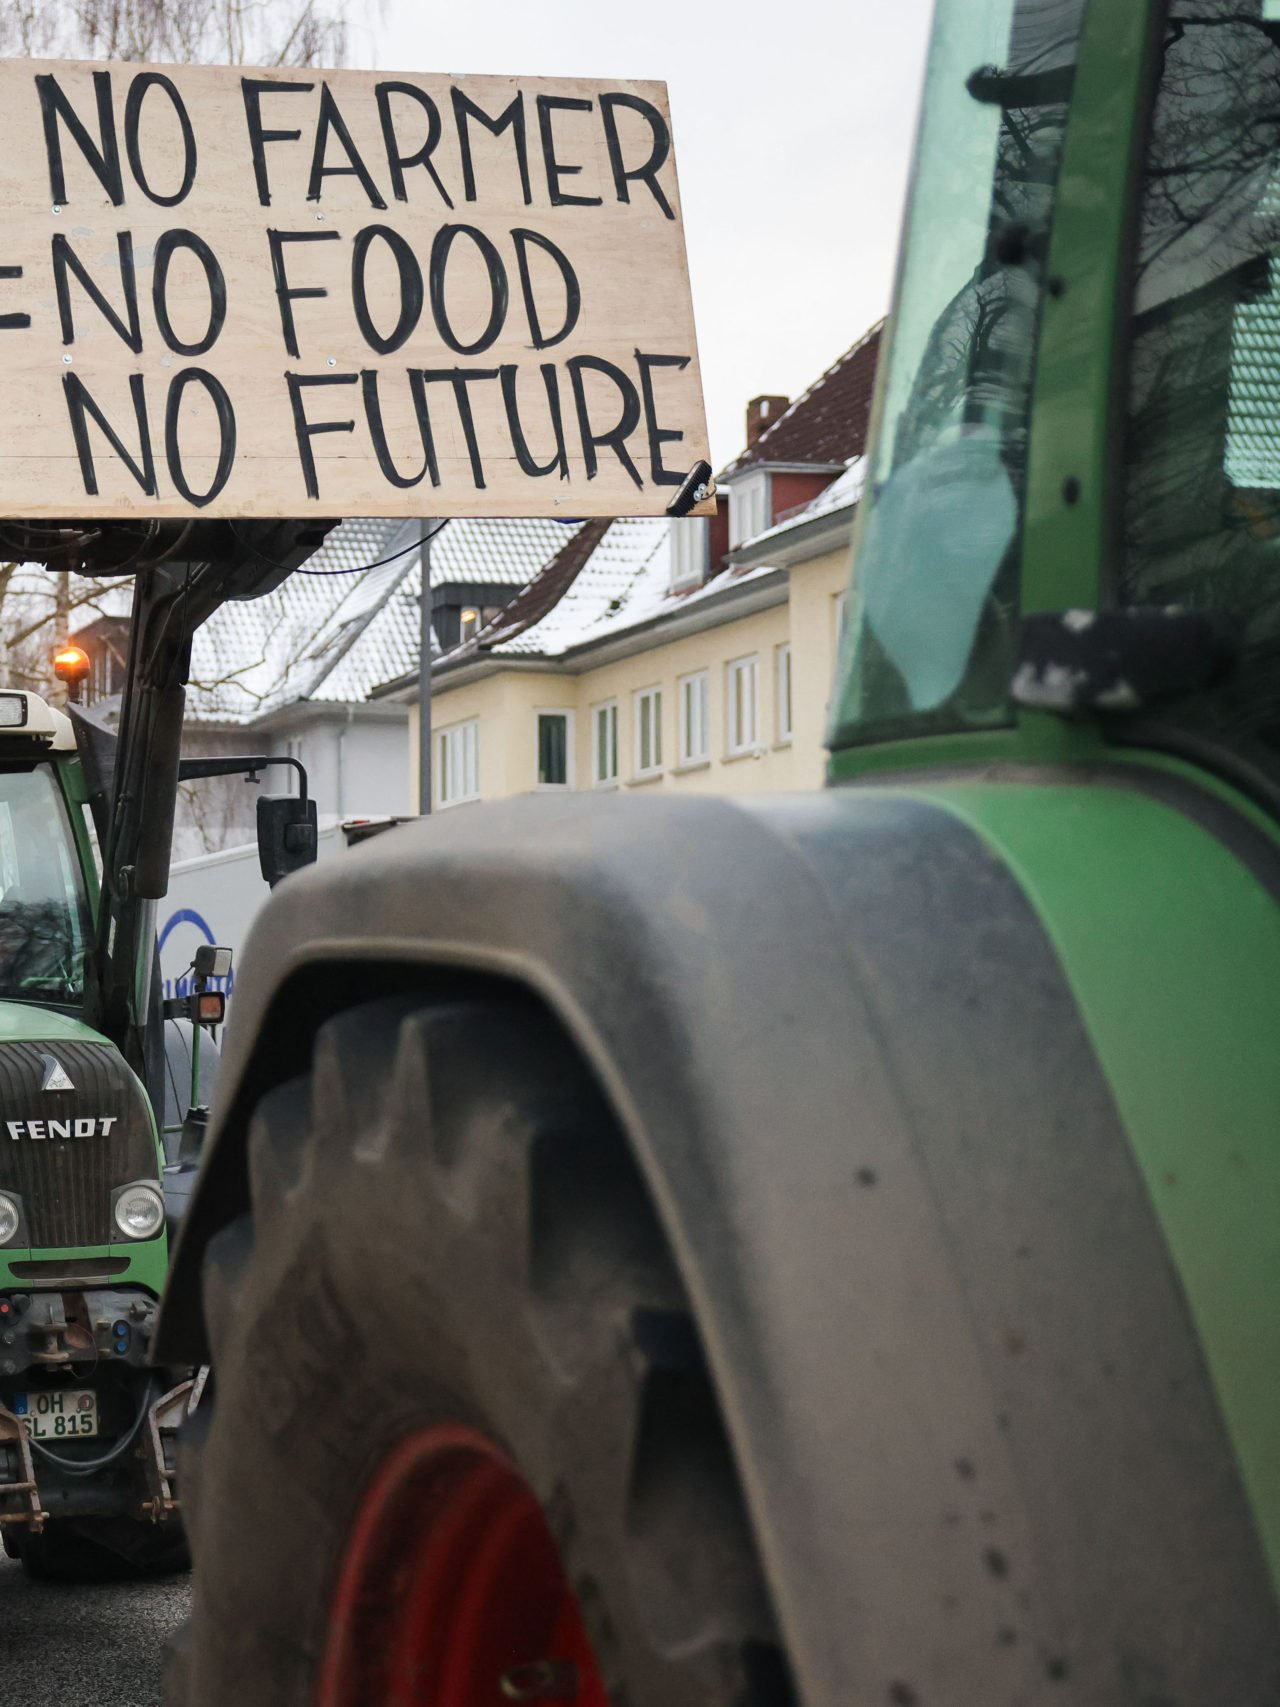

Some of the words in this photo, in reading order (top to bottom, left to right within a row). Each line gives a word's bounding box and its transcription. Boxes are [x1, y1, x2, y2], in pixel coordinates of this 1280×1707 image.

[35, 71, 198, 208] NO
[241, 77, 676, 221] FARMER
[52, 229, 227, 357] NO
[267, 224, 581, 356] FOOD
[62, 367, 237, 509] NO
[284, 348, 692, 500] FUTURE
[6, 1117, 118, 1141] FENDT
[36, 1393, 64, 1414] OH
[54, 1414, 93, 1436] 815
